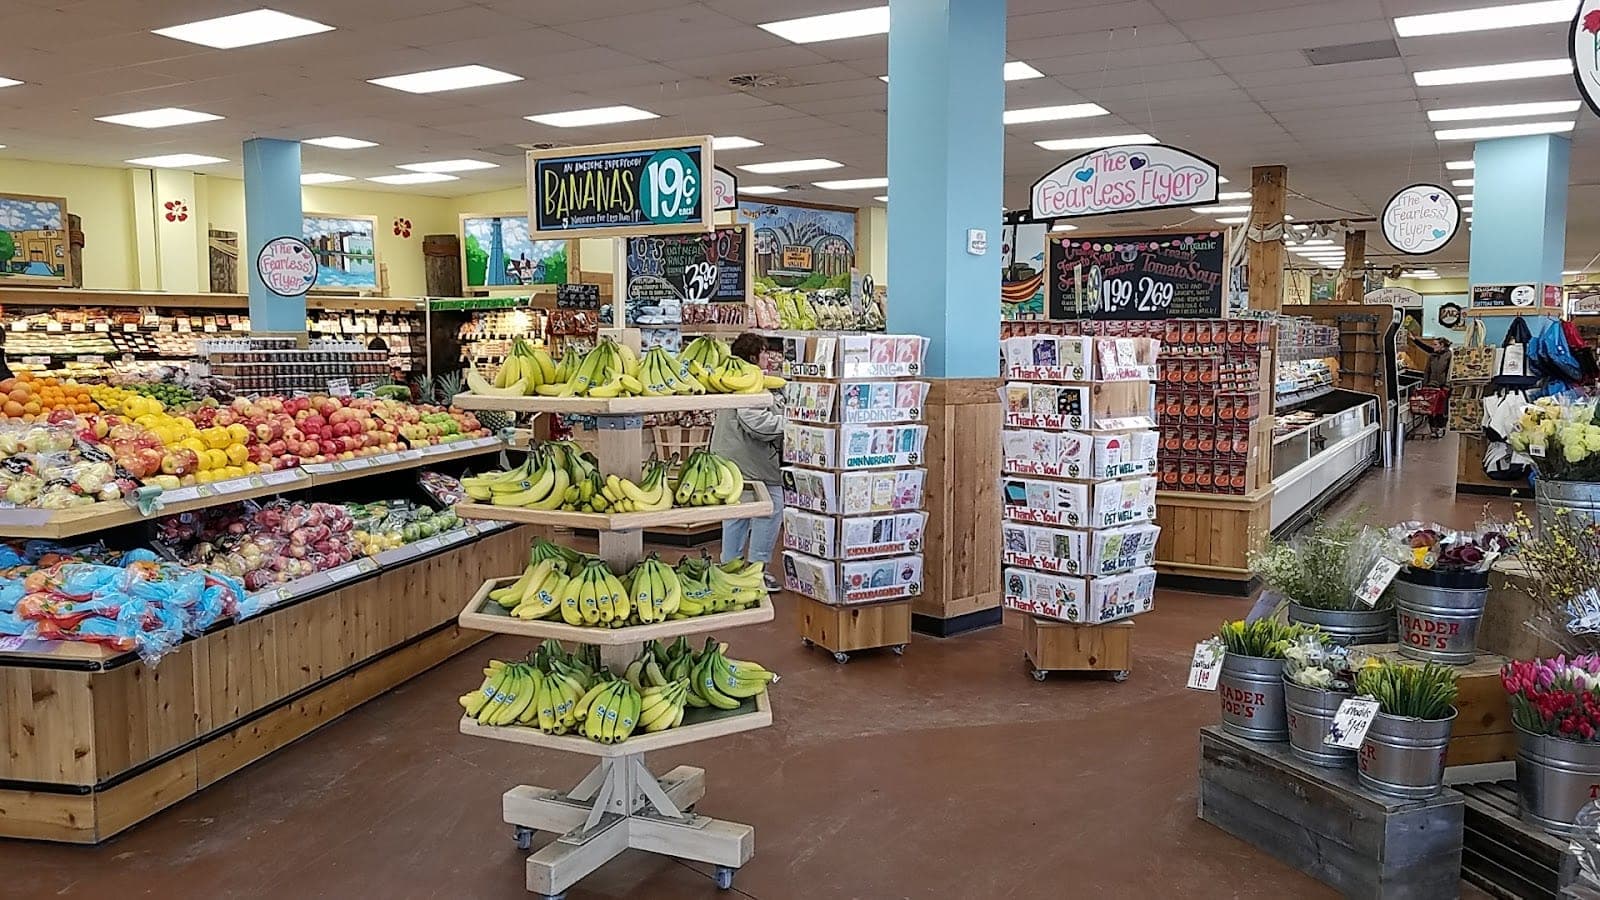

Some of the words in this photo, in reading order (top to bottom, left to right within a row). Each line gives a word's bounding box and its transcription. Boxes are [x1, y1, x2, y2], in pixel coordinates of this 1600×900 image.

[575, 160, 603, 172] AWESOME
[1090, 151, 1126, 173] The
[544, 168, 634, 220] BANANAS
[1042, 175, 1136, 212] Fearless
[1142, 169, 1204, 205] Flyer
[1402, 195, 1420, 207] The
[1392, 205, 1445, 223] Fearless
[1399, 222, 1433, 247] Flyer
[274, 243, 292, 254] The
[263, 257, 310, 273] Fearless
[1141, 253, 1187, 278] Tomato
[1186, 261, 1222, 291] Soup
[272, 273, 305, 290] Flyer
[847, 410, 898, 421] WEDDING
[1105, 463, 1120, 477] GET
[1119, 460, 1135, 473] WELL
[1104, 511, 1117, 525] GET
[1117, 509, 1133, 521] WELL
[847, 543, 905, 558] ENCOURAGEMENT
[847, 585, 905, 600] ENCOURAGEMENT
[1404, 630, 1448, 650] JOE'S
[1221, 684, 1265, 706] RADER
